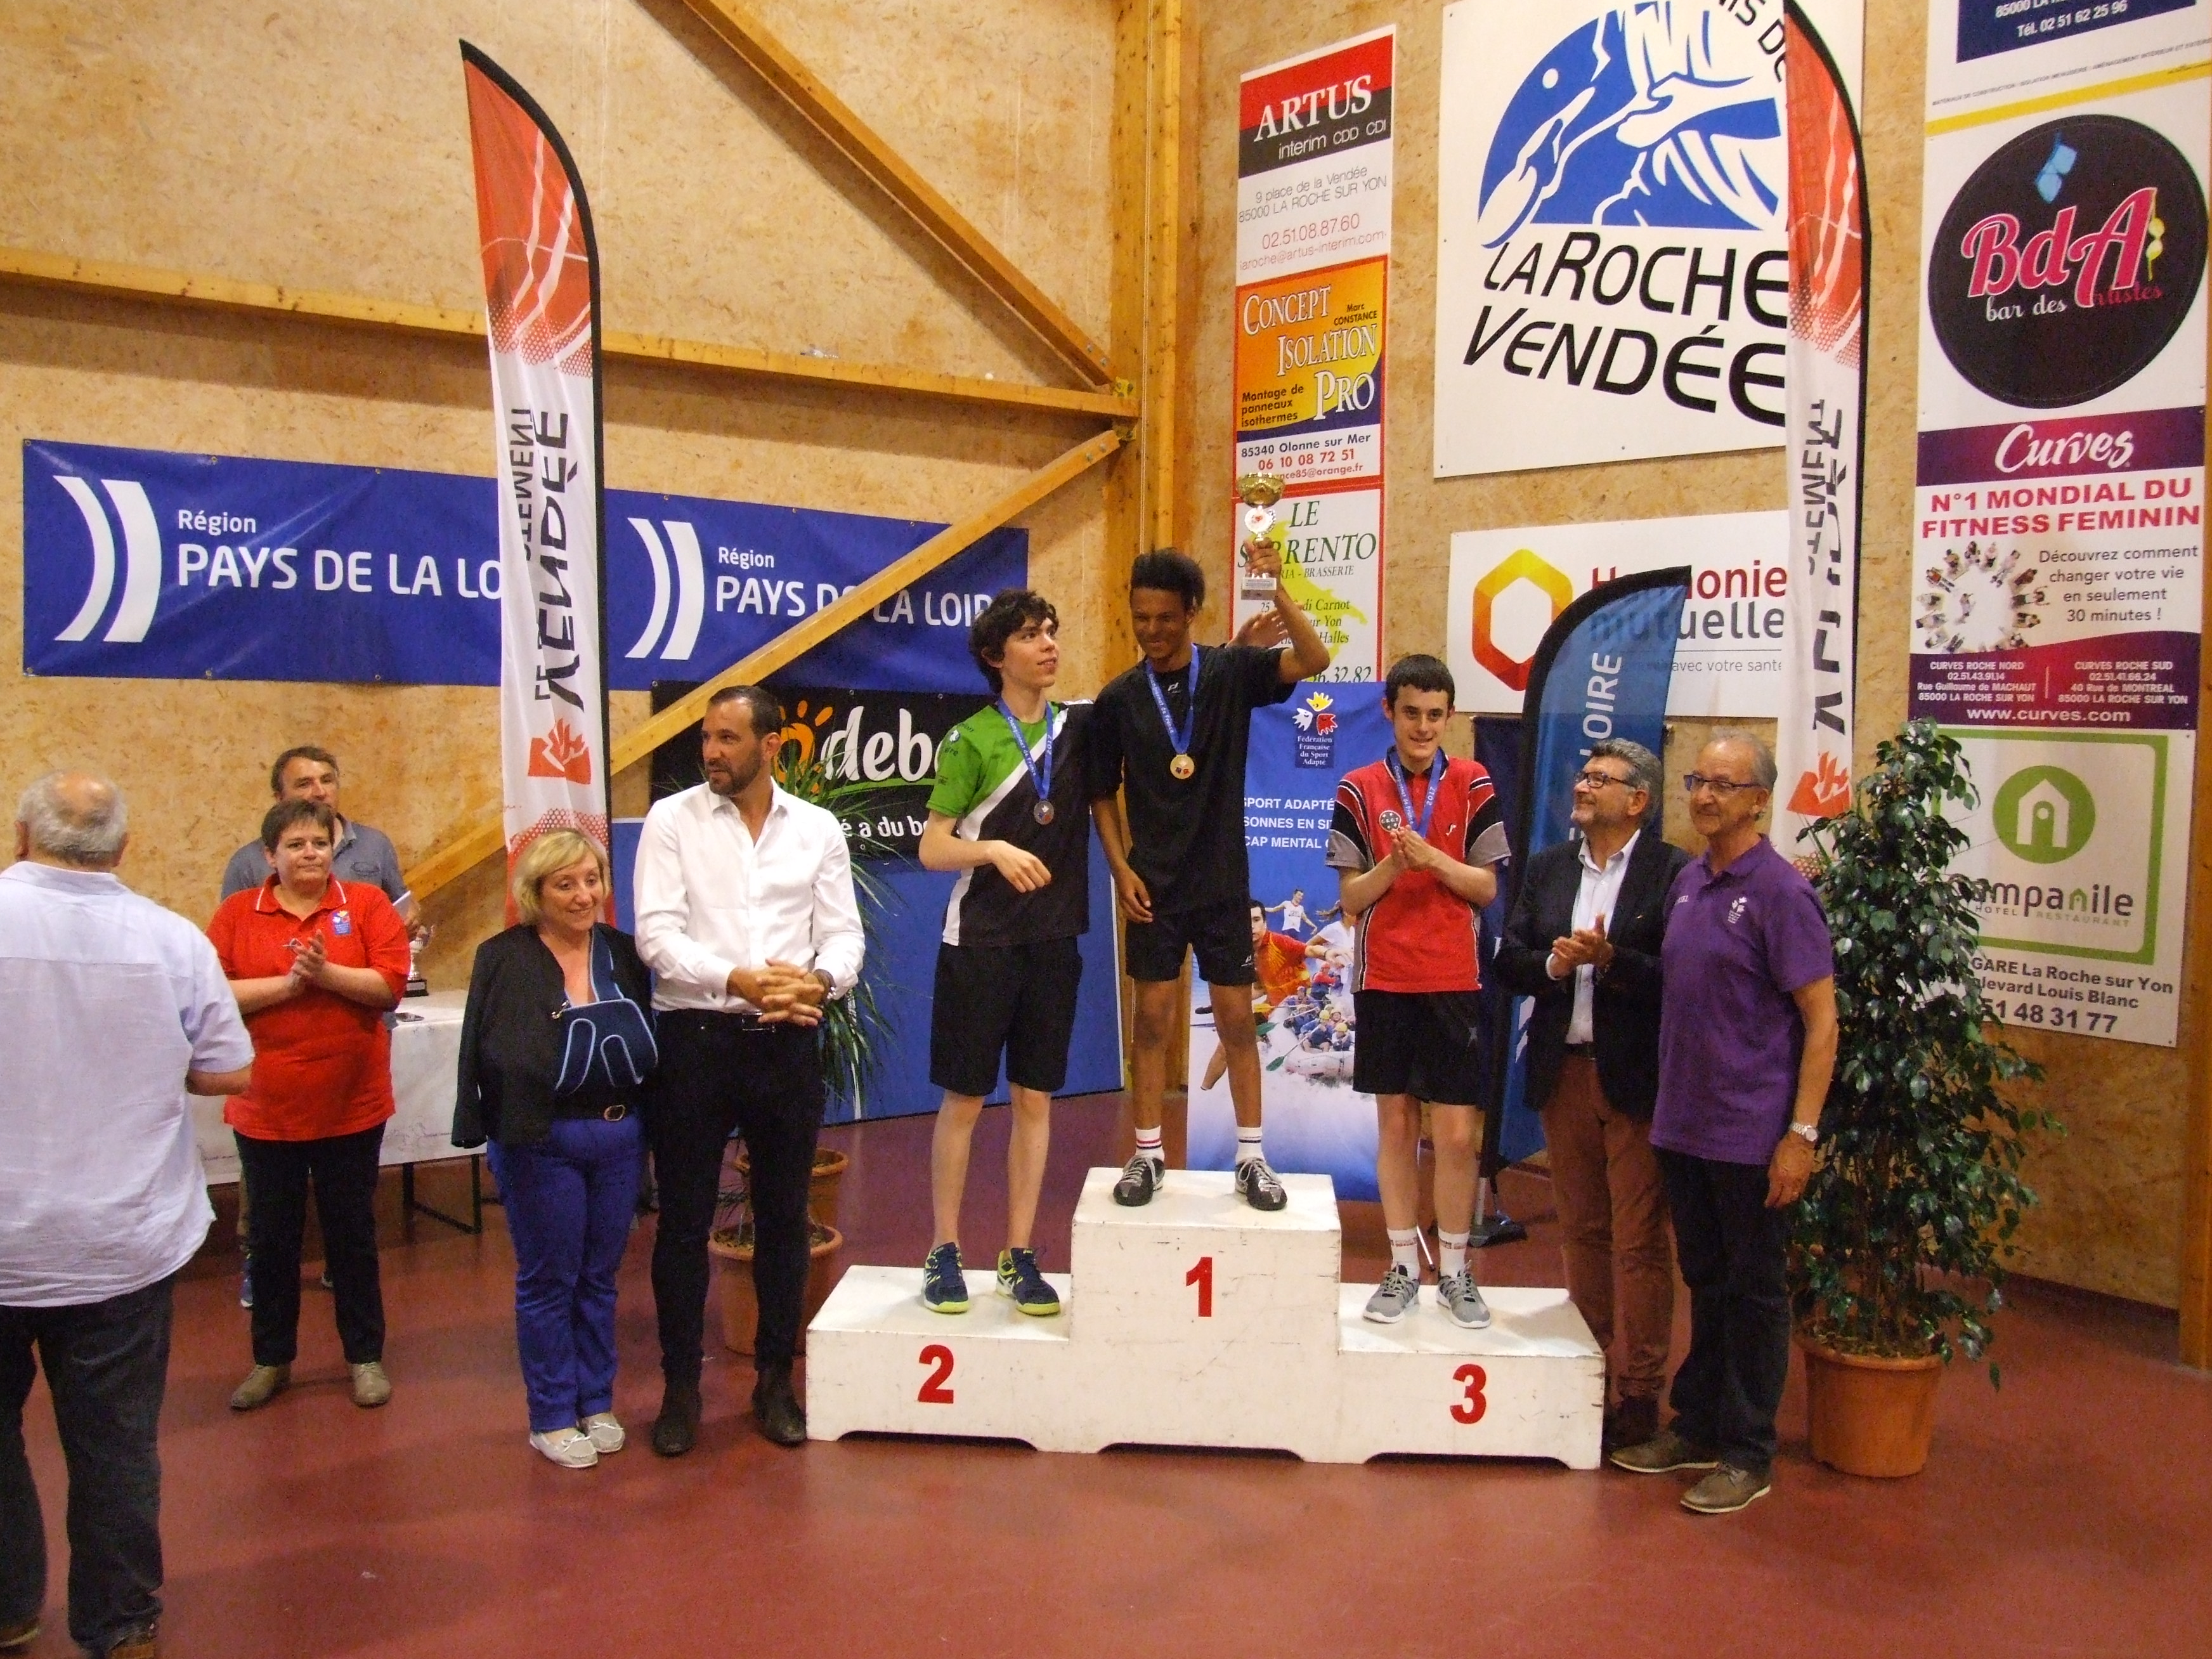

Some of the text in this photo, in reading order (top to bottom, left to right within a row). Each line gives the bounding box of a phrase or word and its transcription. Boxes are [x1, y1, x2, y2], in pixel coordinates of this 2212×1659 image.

[2040, 18, 2055, 32] 02
[2057, 13, 2072, 28] 51
[2093, 4, 2109, 19] 25
[1254, 75, 1372, 141] ARTUS
[1278, 119, 1387, 160] interim CDD CDI
[1256, 166, 1367, 205] 9 place de la Vendée
[1239, 176, 1387, 223] 85000 LA ROCHE SUR YON
[1262, 213, 1360, 250] 02.51.08.87.60
[1961, 186, 2157, 308] BdA
[1540, 231, 1788, 329] ROCHE
[1244, 283, 1331, 336] CONCEPT
[1333, 310, 1378, 326] CONSTANCE
[1346, 303, 1365, 313] Marc
[1986, 295, 2024, 322] bar
[2033, 293, 2067, 316] des
[1276, 323, 1377, 377] ISOLATION
[1462, 304, 1786, 427] VENDÉE
[1241, 384, 1304, 403] Montage de
[1313, 370, 1376, 420] PRO
[1240, 398, 1293, 417] panneaux
[1240, 411, 1298, 428] isothermes
[1241, 433, 1371, 459] 85340 Olonne sur Mer
[1994, 423, 2135, 474] Curves
[1258, 448, 1355, 471] 06 10 08 72 51
[1280, 462, 1363, 481] nce85@orange.fr
[1987, 481, 2135, 509] MONDIAL
[2144, 478, 2192, 500] DU
[178, 509, 257, 536] Région
[1289, 500, 1320, 528] LE
[1922, 505, 2200, 539] FITNESS FEMININ
[718, 546, 775, 568] Région
[2038, 545, 2199, 564] Découvrez comment
[178, 543, 503, 600] PAYS DE LA LO
[1303, 565, 1355, 578] BRASSERIE
[2049, 568, 2185, 585] changer votre vie
[715, 575, 806, 617] PAYS
[873, 589, 914, 625] LA
[1315, 599, 1351, 611] Carnot
[2063, 588, 2168, 602] en seulement
[1324, 615, 1342, 627] Yon
[2066, 608, 2162, 622] 30 minutes !
[1319, 630, 1350, 644] Halles
[1672, 660, 1703, 672] avec
[1707, 659, 1742, 672] votre
[1930, 661, 2025, 670] CURVES ROCHE NORD
[2074, 661, 2173, 670] CURVES ROCHE SUD
[1917, 682, 2037, 691] Rue Guillaume de MACHAUT
[1918, 693, 2035, 702] 85000 LA ROCHE SUR YON
[2086, 684, 2104, 692] Rue
[2106, 684, 2119, 692] de
[2122, 684, 2175, 693] MONTREAL
[2058, 694, 2188, 704] 85000 LA ROCHE SUR YON
[1967, 708, 2131, 722] www.curves.com
[1311, 751, 1329, 759] Sport
[1284, 798, 1335, 810] ADAPTÉ
[1426, 786, 1435, 806] 2017
[858, 822, 872, 838] a
[878, 816, 904, 837] du
[1297, 819, 1315, 829] EN
[1271, 836, 1322, 849] MENTAL
[1975, 905, 2130, 927] HOTEL RESTAURANT
[1971, 957, 2174, 994] GARE La Roche sur Yon
[2038, 983, 2139, 1009] Louis Blanc
[2014, 1002, 2043, 1024] 48
[2050, 1007, 2078, 1029] 31
[2086, 1011, 2118, 1034] 77
[1185, 1256, 1214, 1317] 1
[918, 1344, 955, 1405] 2
[1449, 1363, 1487, 1425] 3
